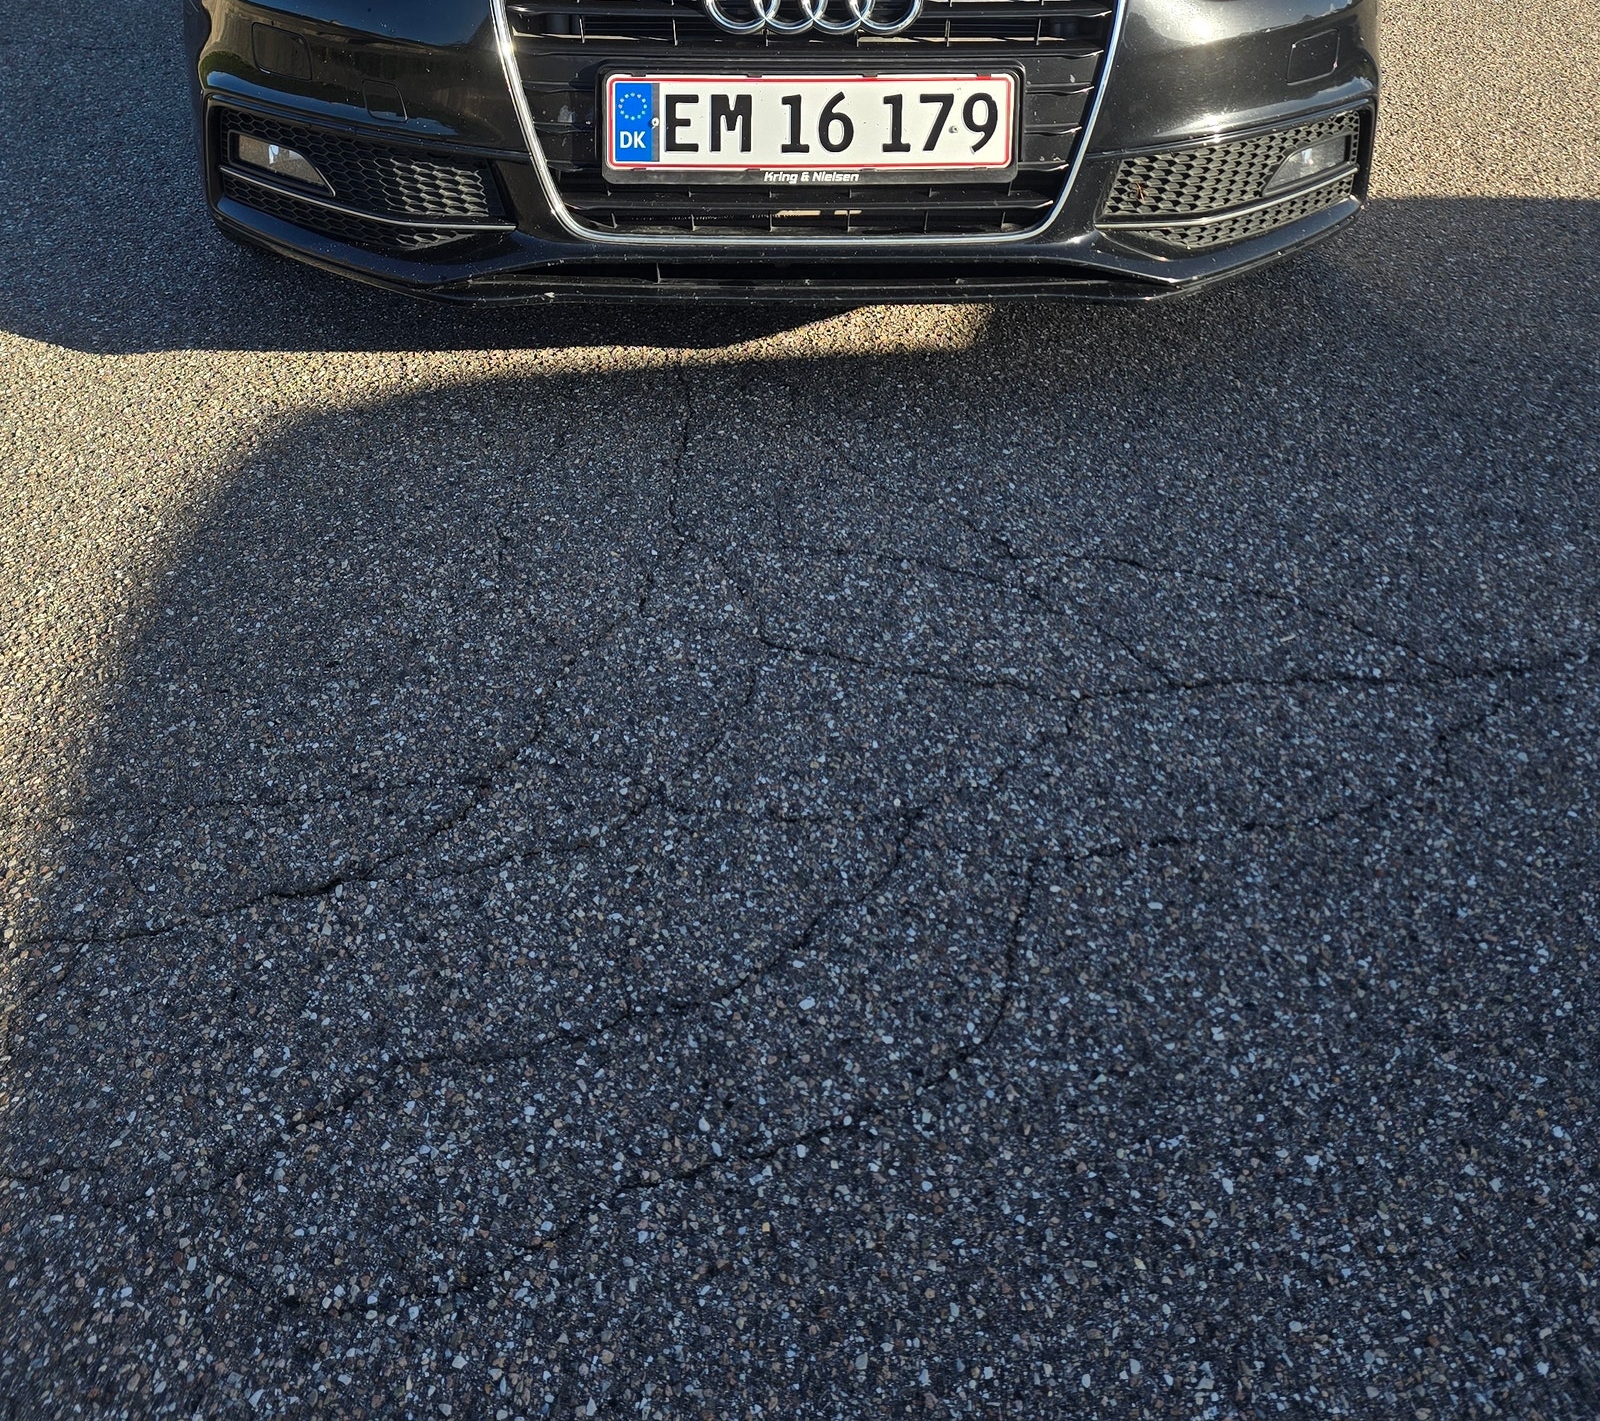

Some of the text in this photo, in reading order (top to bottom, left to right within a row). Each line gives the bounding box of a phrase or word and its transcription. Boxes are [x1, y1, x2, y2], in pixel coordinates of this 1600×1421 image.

[664, 92, 999, 154] EM 16 179
[619, 130, 647, 149] DK
[763, 171, 860, 185] Kring & Nielsen
